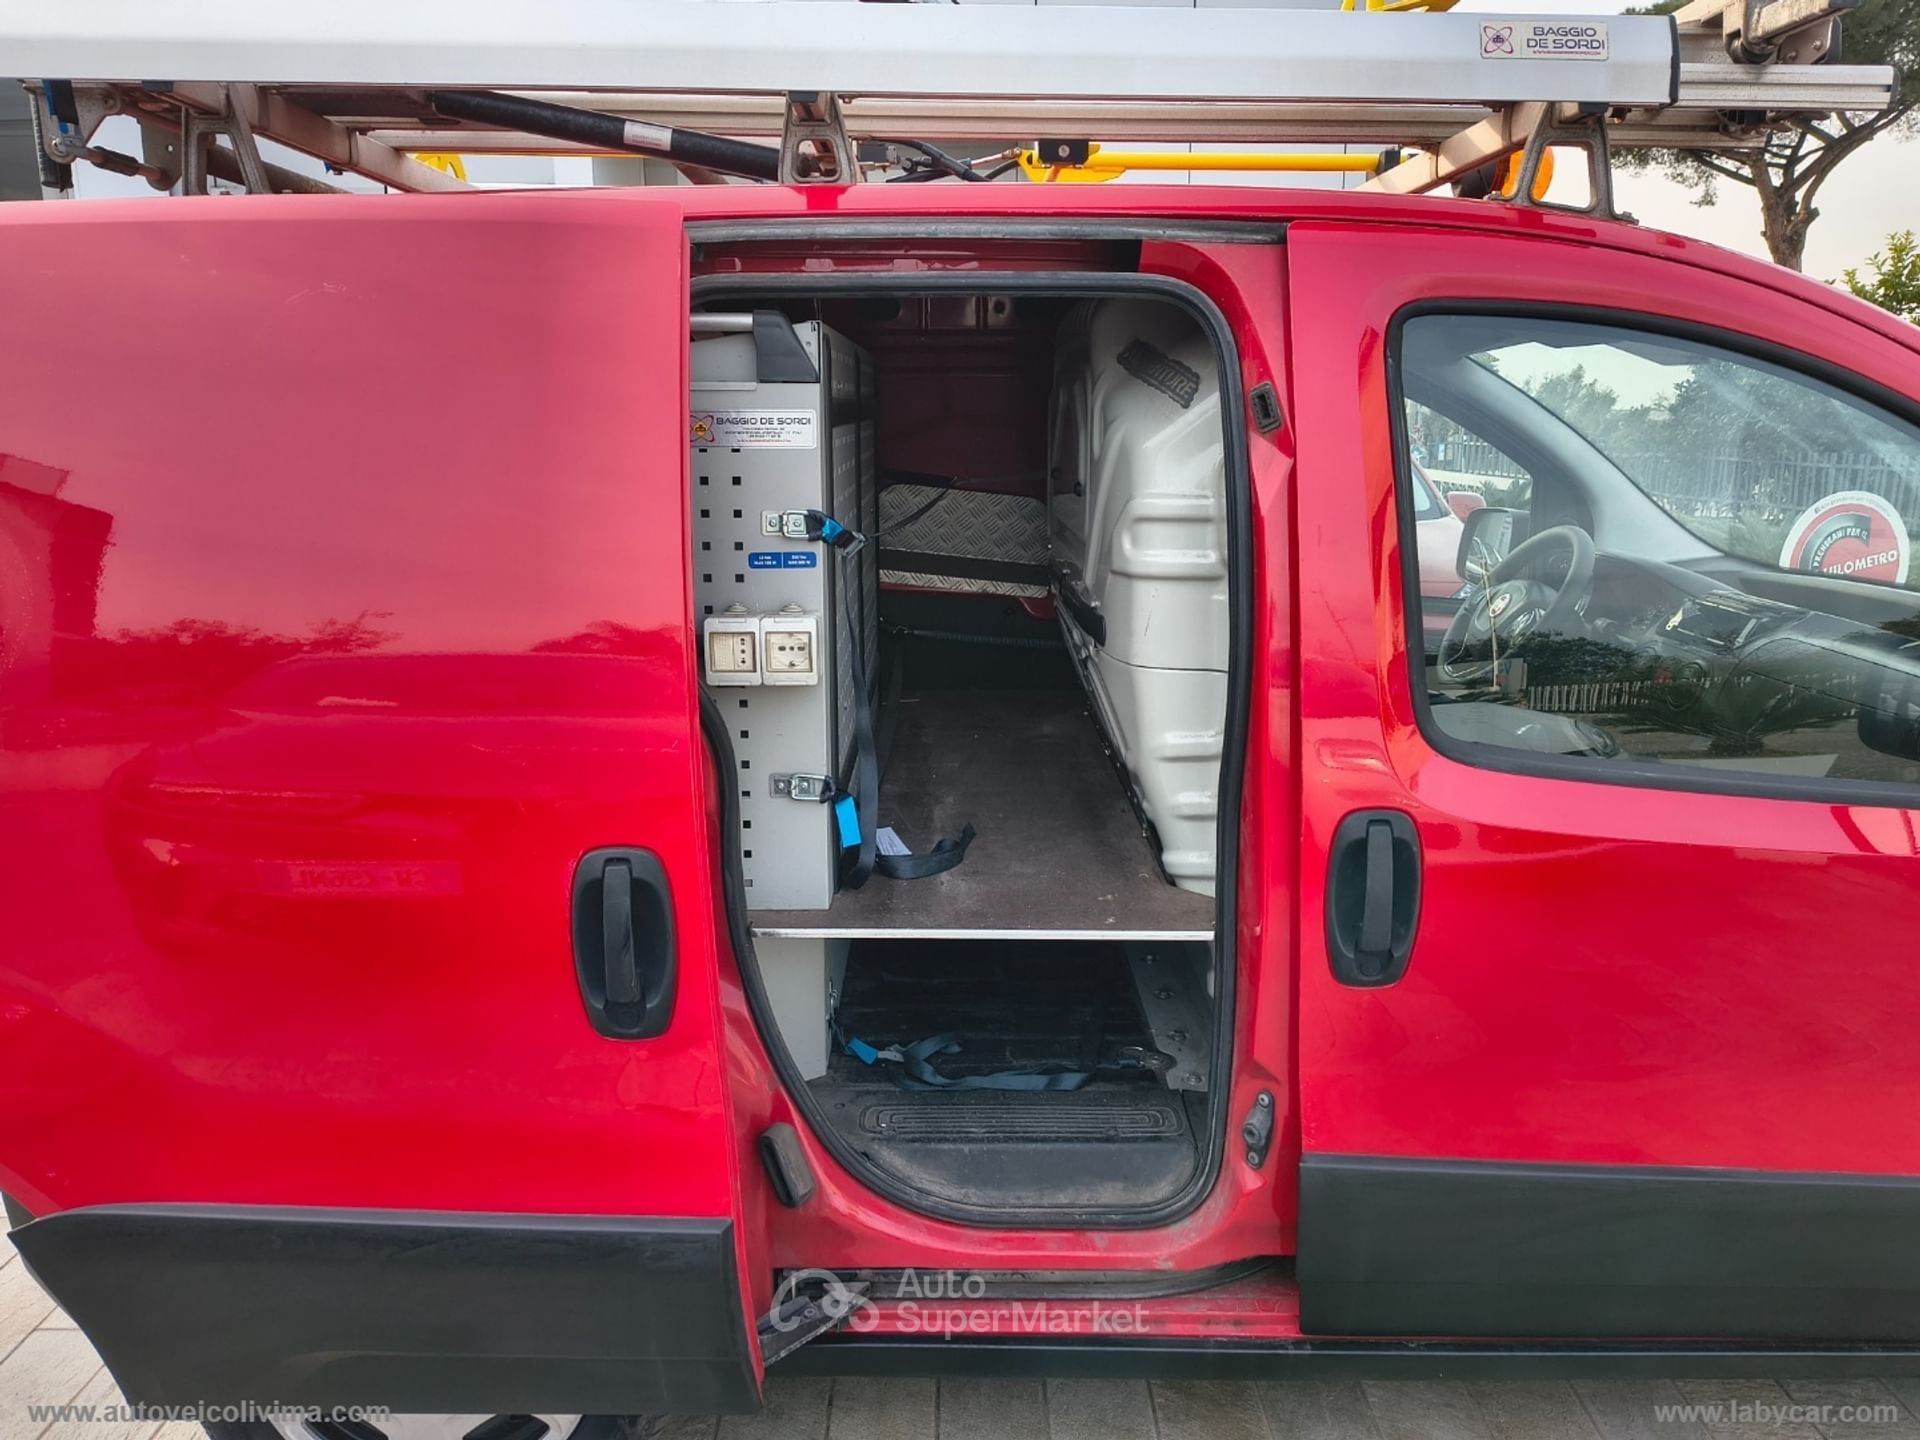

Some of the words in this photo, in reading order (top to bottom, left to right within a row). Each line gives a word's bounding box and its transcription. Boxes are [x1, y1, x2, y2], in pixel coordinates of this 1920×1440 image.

[1533, 26, 1597, 37] BAGGIO
[1526, 38, 1549, 49] DE
[1552, 38, 1605, 50] SORDI
[716, 417, 758, 426] BAGGIO
[760, 417, 775, 426] DE
[777, 417, 811, 426] SORDI
